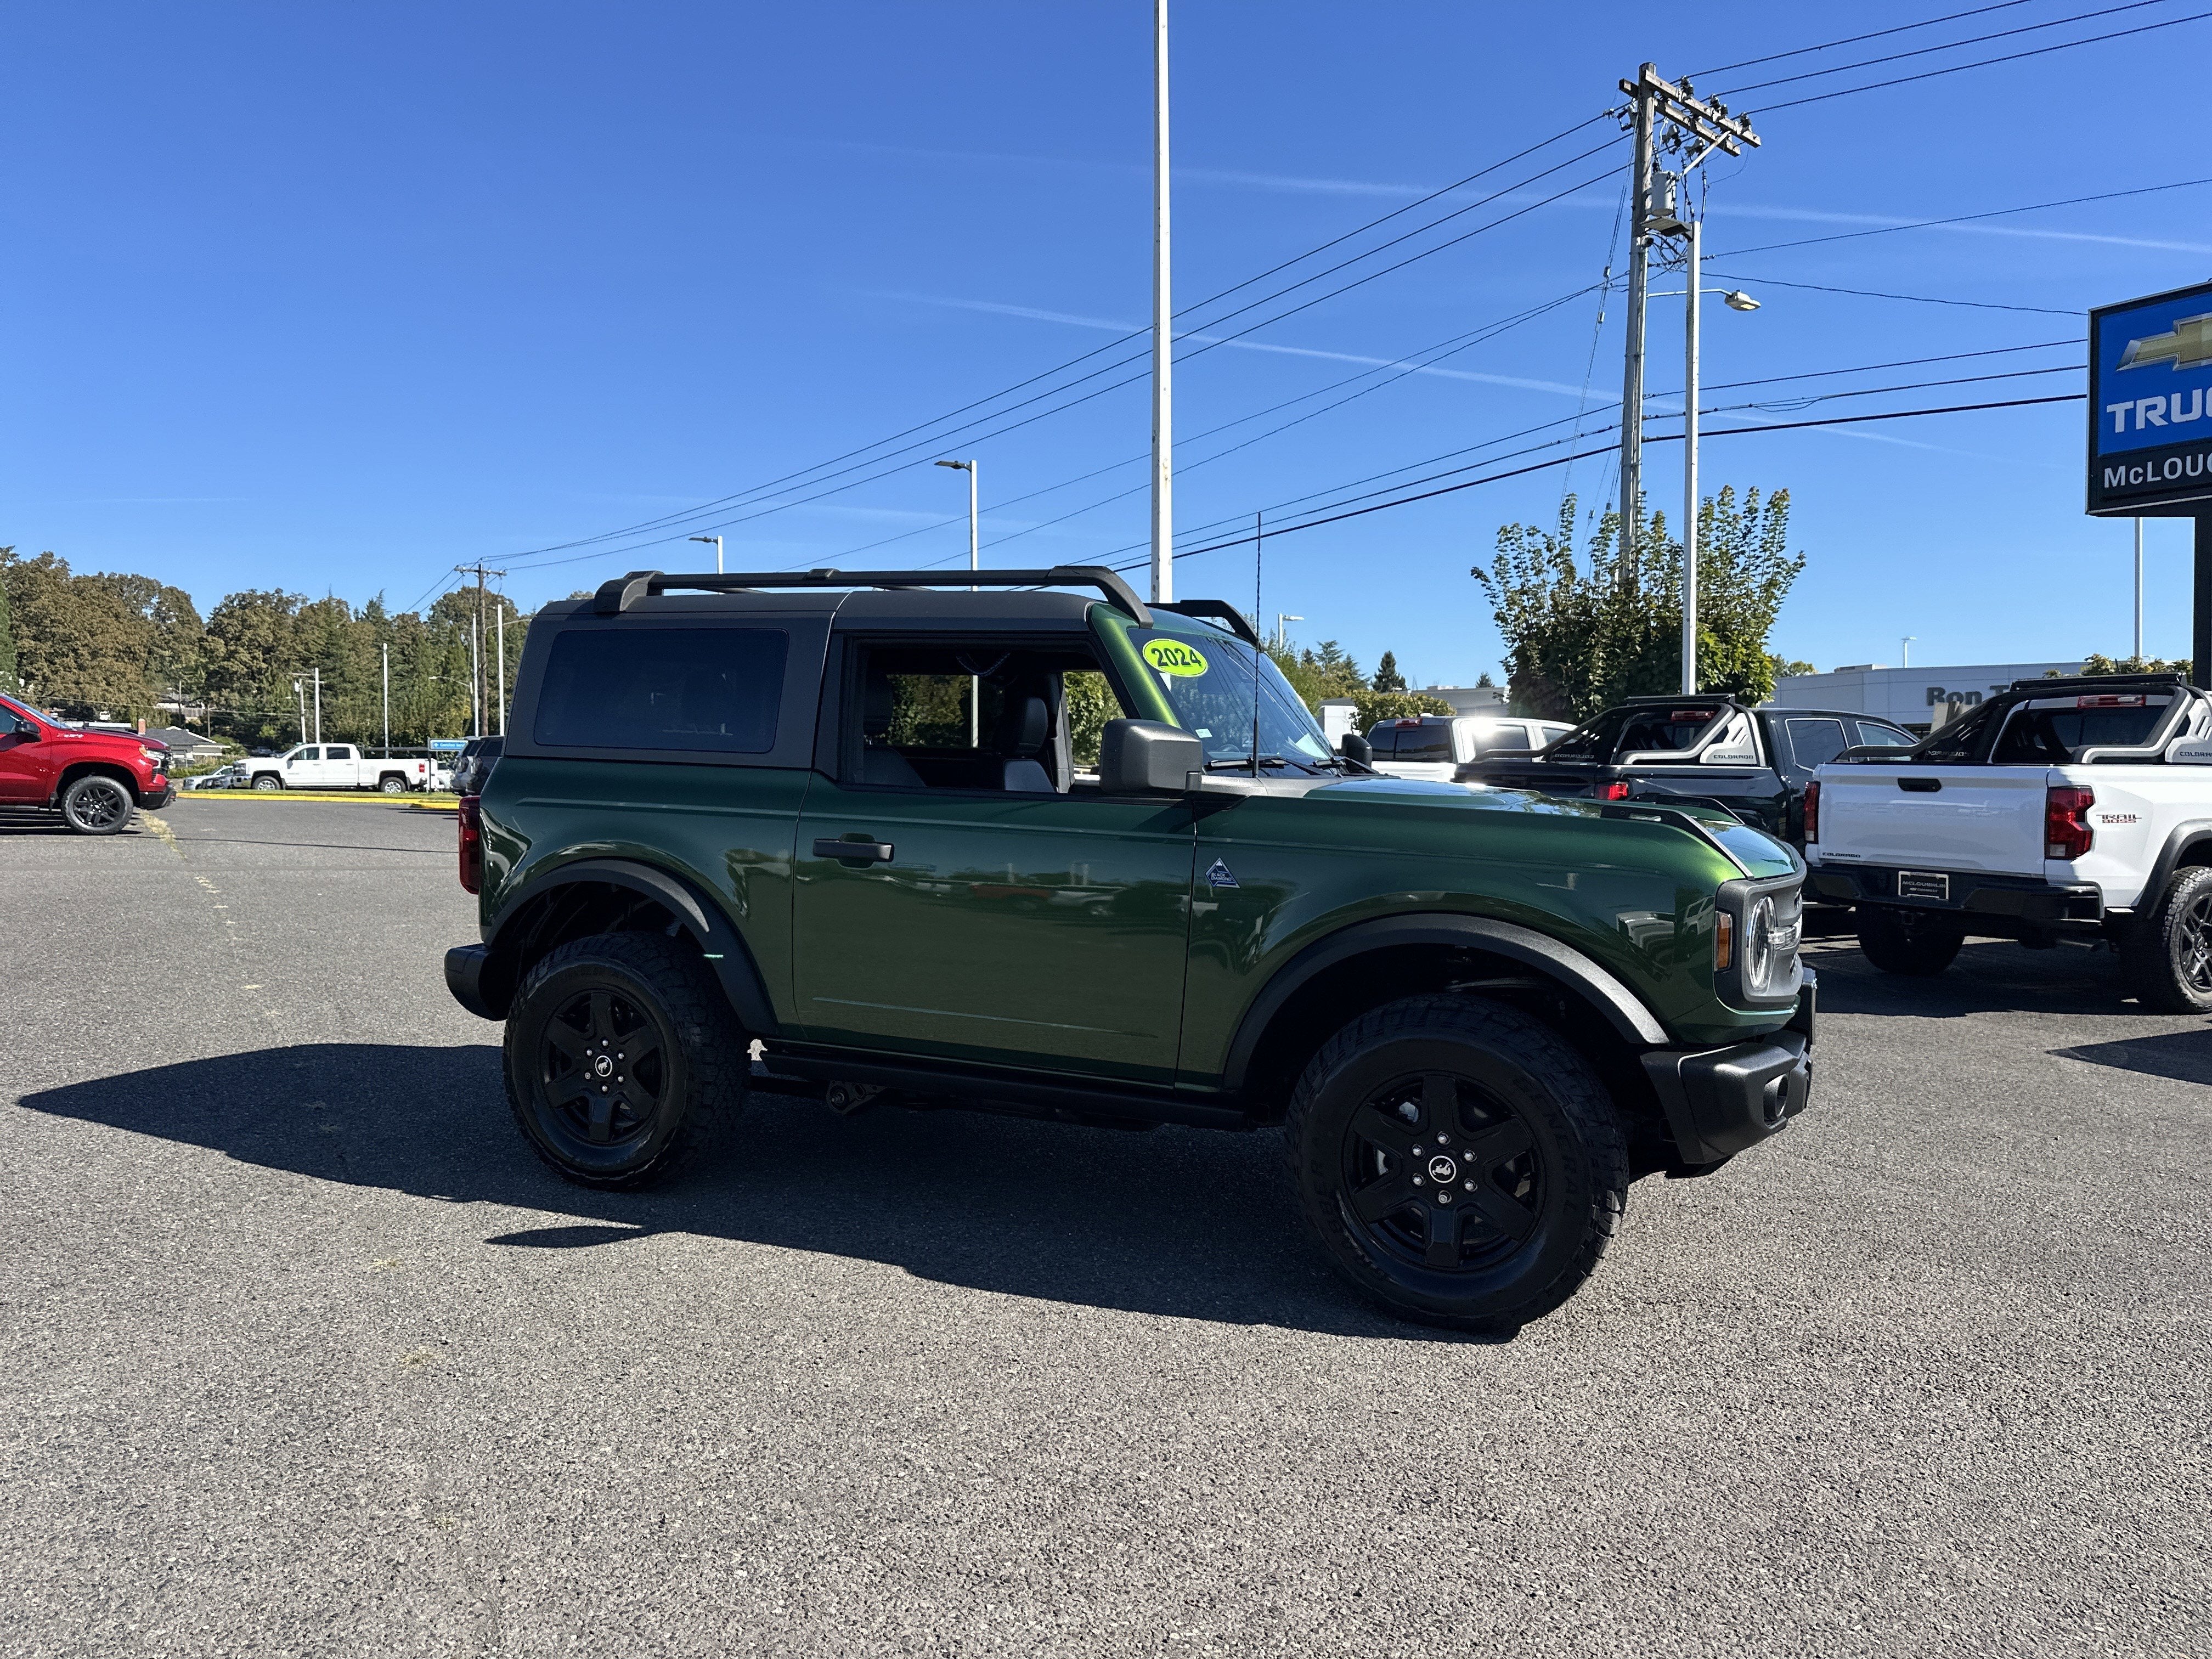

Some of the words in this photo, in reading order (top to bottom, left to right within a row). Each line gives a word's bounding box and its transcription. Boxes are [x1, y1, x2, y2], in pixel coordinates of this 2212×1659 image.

[2106, 387, 2212, 433] TRU
[2104, 453, 2212, 488] McLOU
[1151, 647, 1201, 667] 2024
[1927, 687, 1982, 706] Ron
